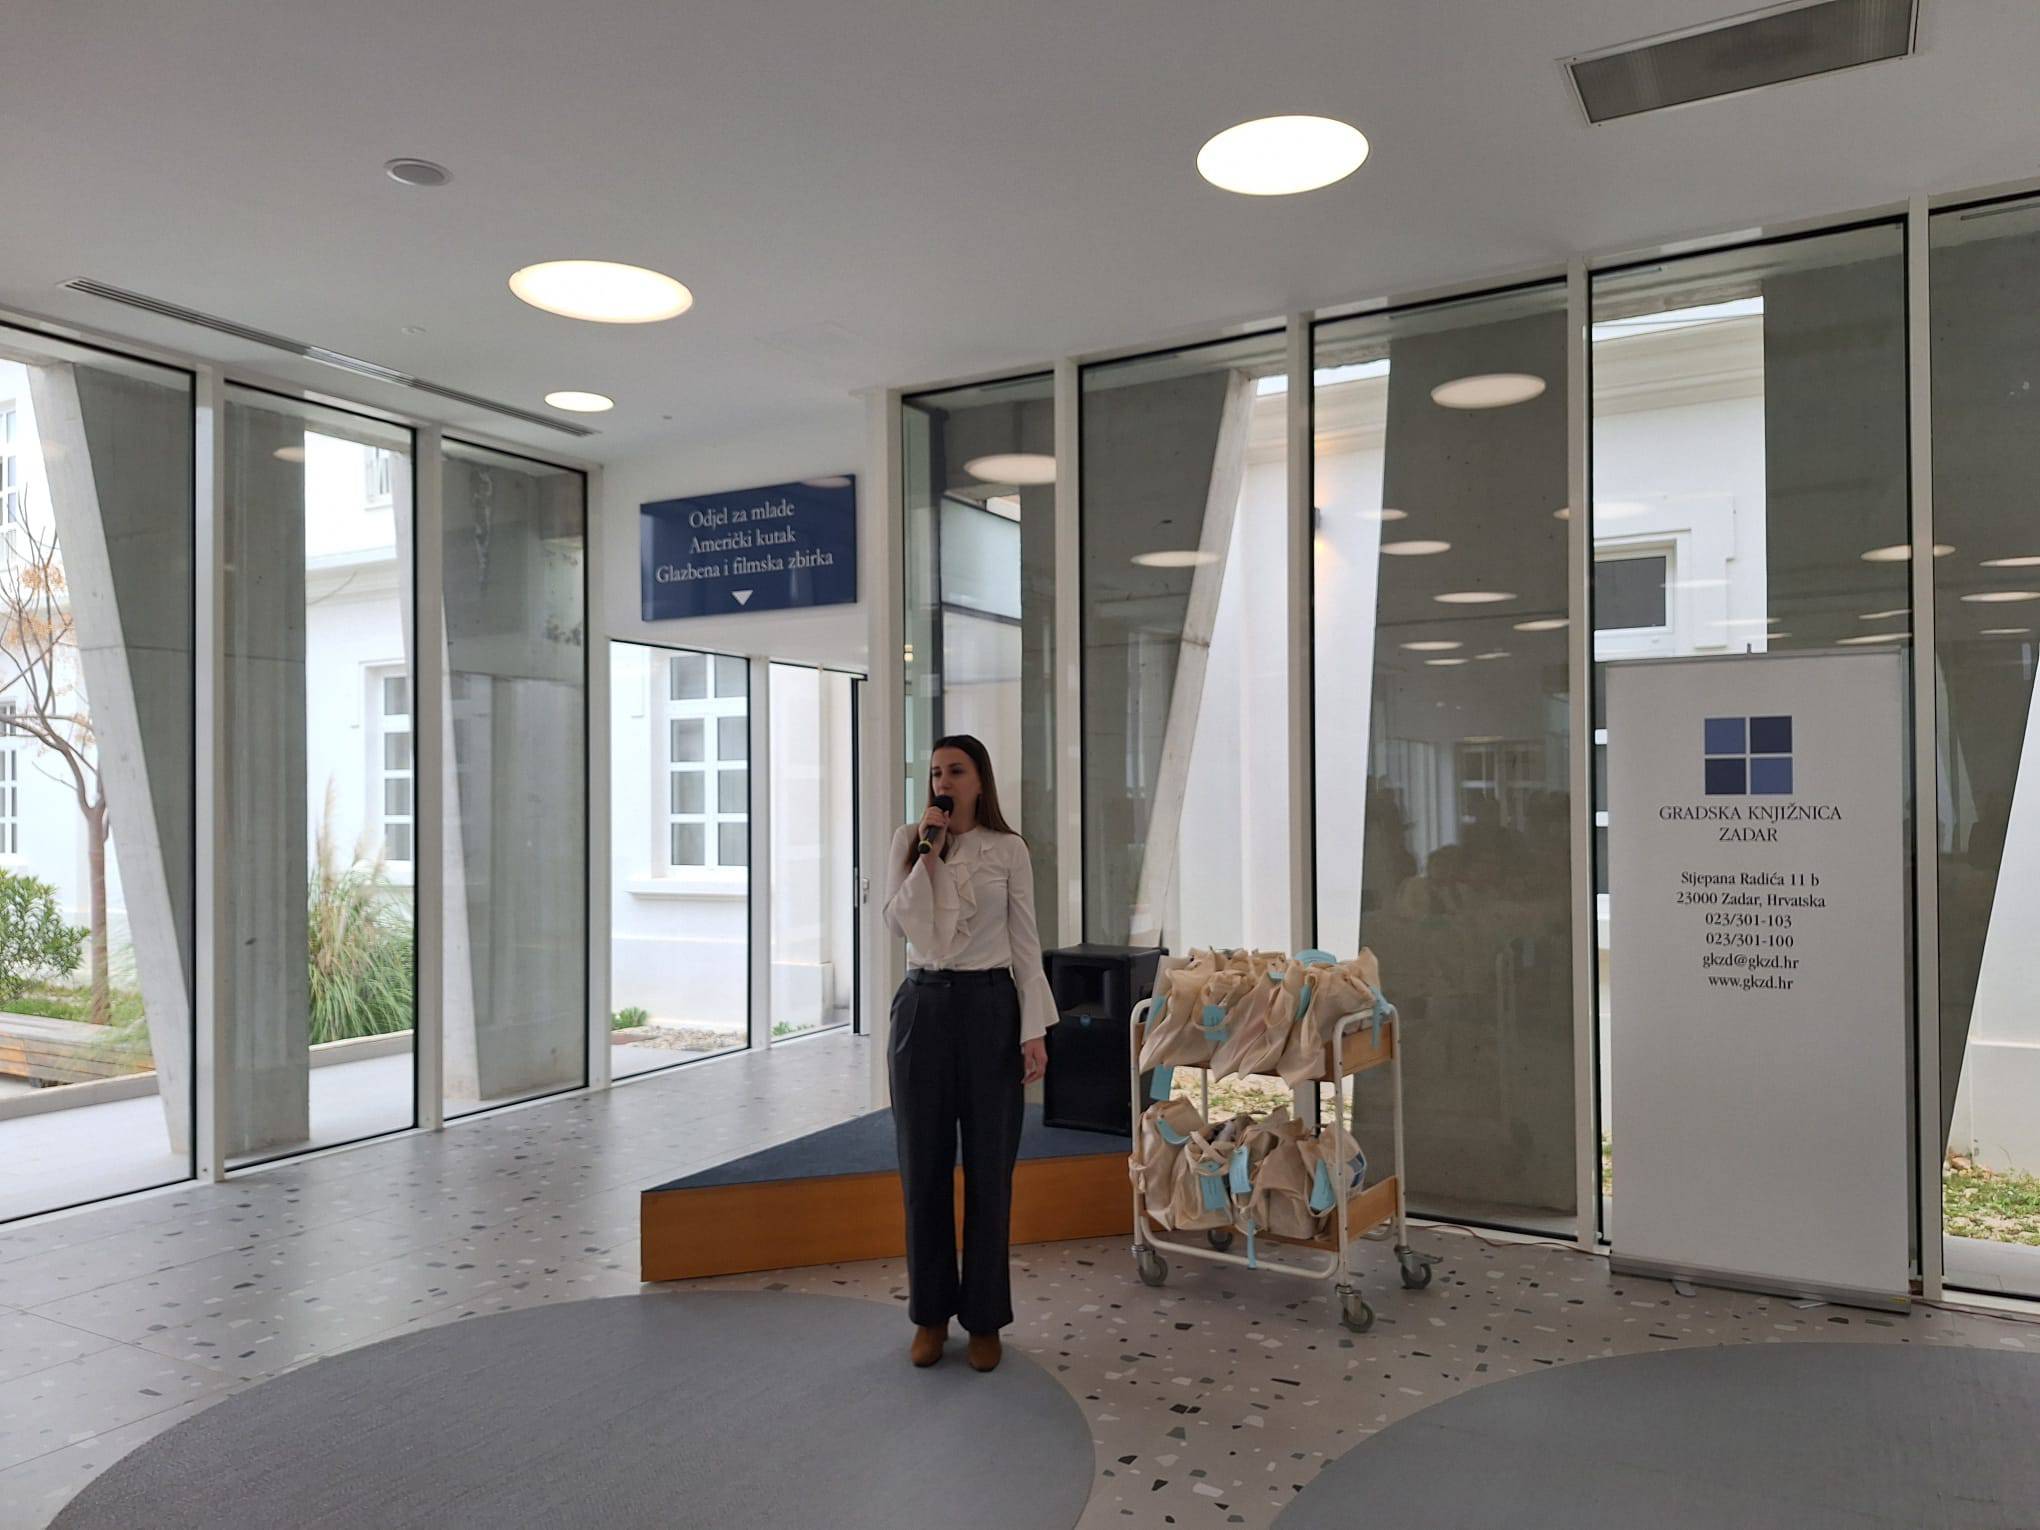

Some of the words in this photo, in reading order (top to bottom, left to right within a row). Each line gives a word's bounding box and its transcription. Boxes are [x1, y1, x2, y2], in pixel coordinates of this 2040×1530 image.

[689, 508, 728, 530] Odjel
[732, 510, 747, 523] za
[752, 499, 795, 520] mlade
[689, 530, 752, 554] Američki
[756, 525, 796, 546] kutak
[656, 563, 720, 583] Glazbena
[723, 559, 729, 576] i
[733, 554, 783, 573] filmska
[788, 549, 833, 569] zbirka
[1659, 805, 1742, 820] GRADSKA
[1749, 803, 1842, 824] KNJIŽNICA
[1719, 827, 1778, 842] ZADAR
[1681, 871, 1736, 887] Stjepana
[1740, 872, 1785, 886] Radića
[1791, 873, 1804, 886] 11
[1811, 873, 1820, 886] b
[1676, 891, 1717, 905] 23000
[1721, 892, 1762, 908] Zadar,
[1767, 893, 1826, 908] Hrvatska
[1705, 912, 1792, 929] 023/301-103
[1706, 932, 1794, 947] 023/301-100
[1702, 952, 1799, 970] gkzd@gkzd.hr
[1708, 975, 1794, 991] www.gkzd.hr
